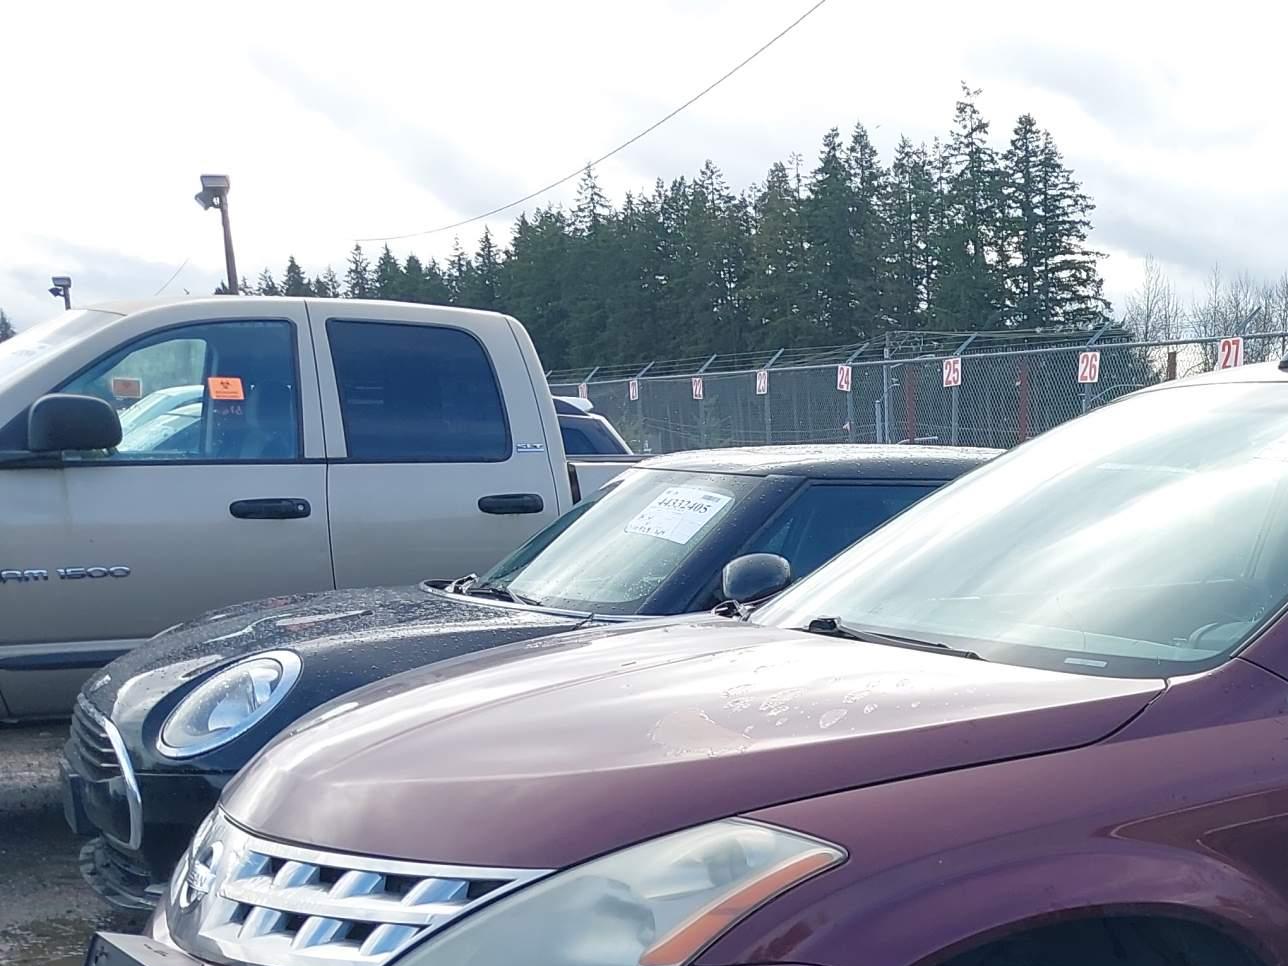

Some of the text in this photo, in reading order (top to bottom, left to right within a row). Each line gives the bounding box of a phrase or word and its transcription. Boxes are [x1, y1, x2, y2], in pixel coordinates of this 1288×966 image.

[1080, 353, 1097, 381] 26
[1221, 340, 1239, 369] 27
[839, 366, 849, 390] 24
[945, 360, 960, 386] 25
[56, 566, 130, 580] 1500
